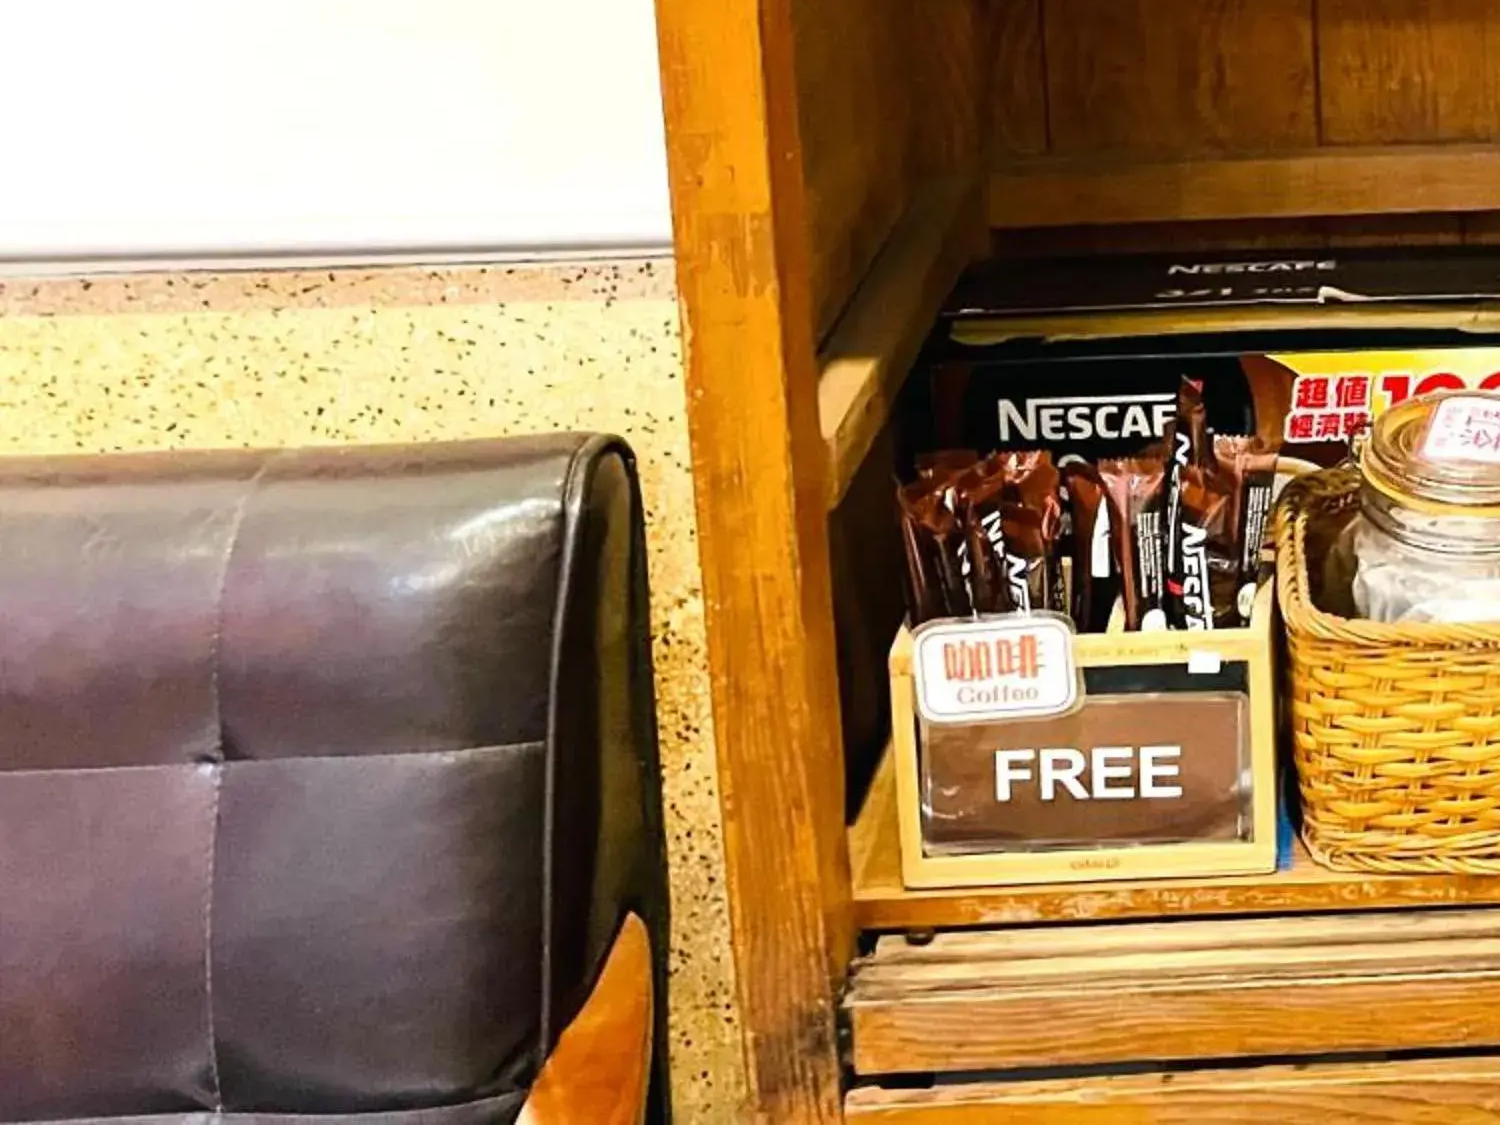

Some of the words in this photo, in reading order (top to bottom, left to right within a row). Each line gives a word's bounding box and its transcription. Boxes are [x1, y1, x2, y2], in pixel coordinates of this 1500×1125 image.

[1296, 376, 1369, 409] 超值
[997, 393, 1177, 442] NESCAF
[1181, 522, 1213, 632] NESCA
[957, 685, 1039, 706] Coffee
[995, 745, 1183, 803] FREE
